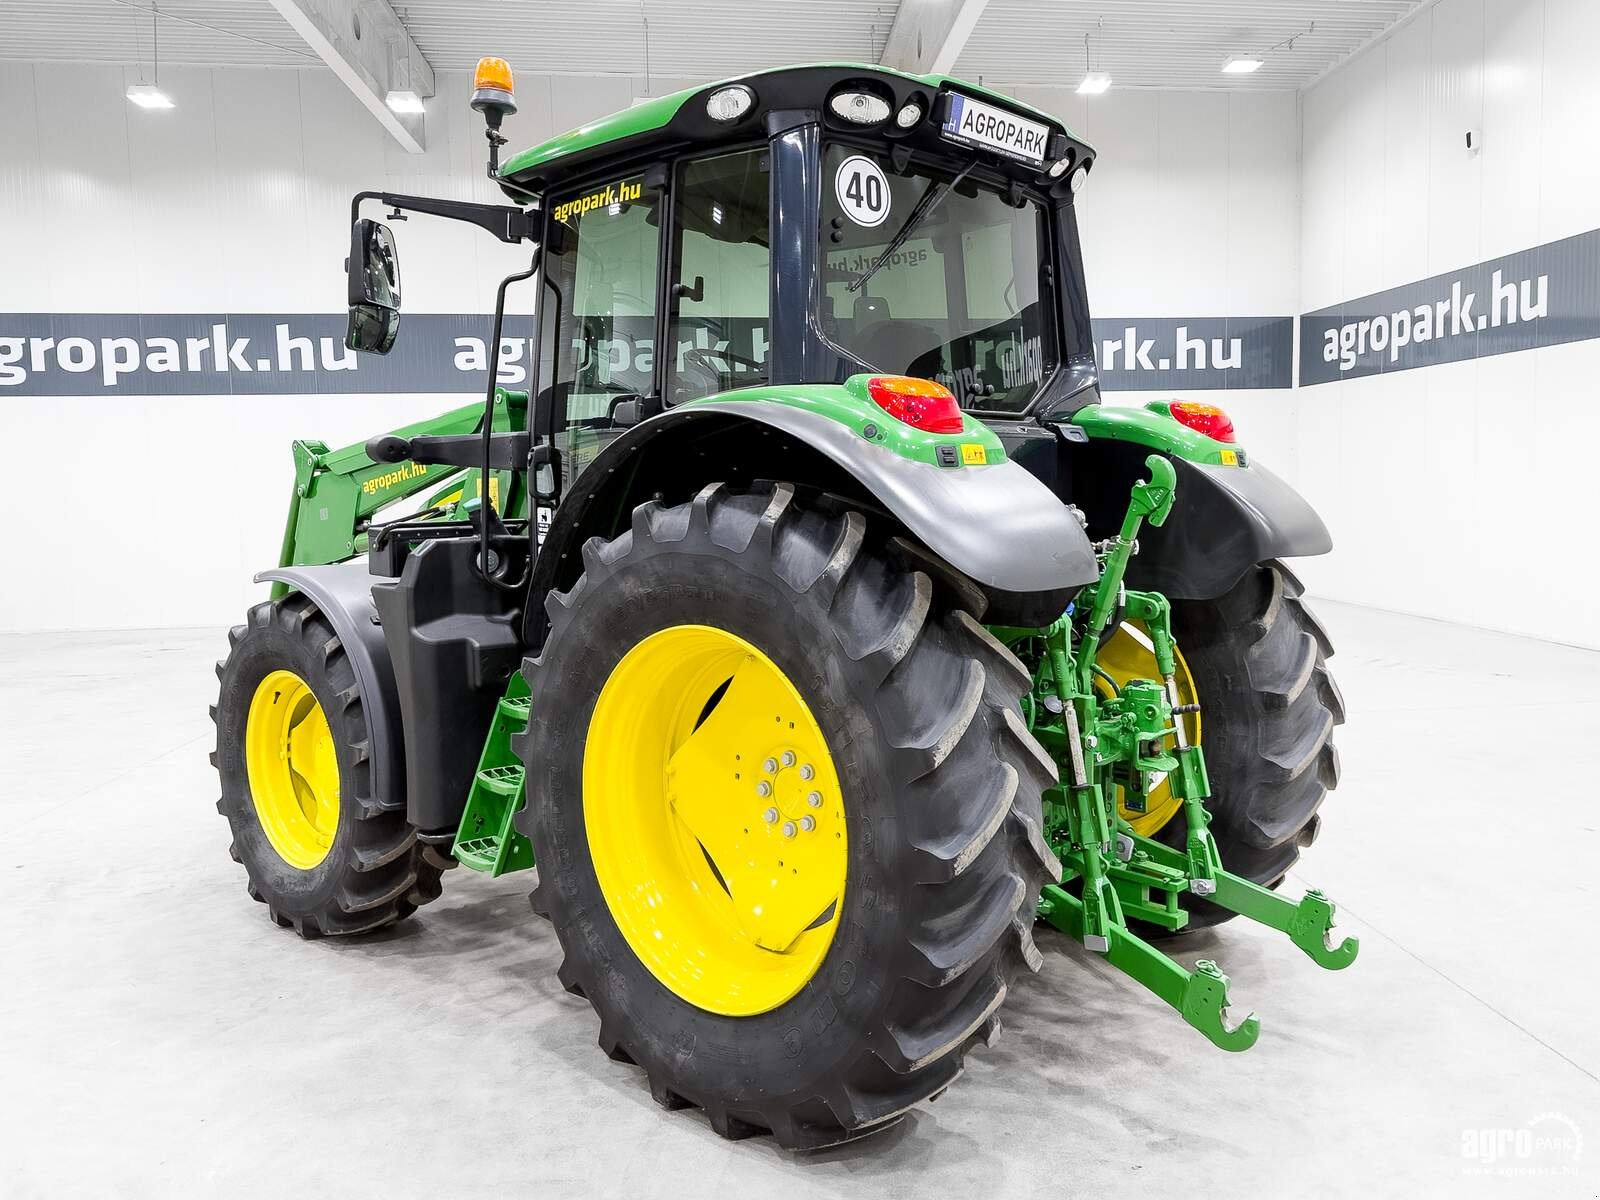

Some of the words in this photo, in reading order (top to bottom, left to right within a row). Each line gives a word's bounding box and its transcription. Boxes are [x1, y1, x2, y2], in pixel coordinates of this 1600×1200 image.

[963, 109, 1045, 155] AGROPARK
[554, 182, 641, 222] agropark.hu
[845, 171, 882, 212] 40
[1323, 269, 1548, 371] agropark.hu
[1093, 326, 1242, 371] rk.hu
[362, 461, 427, 495] agropark.hu
